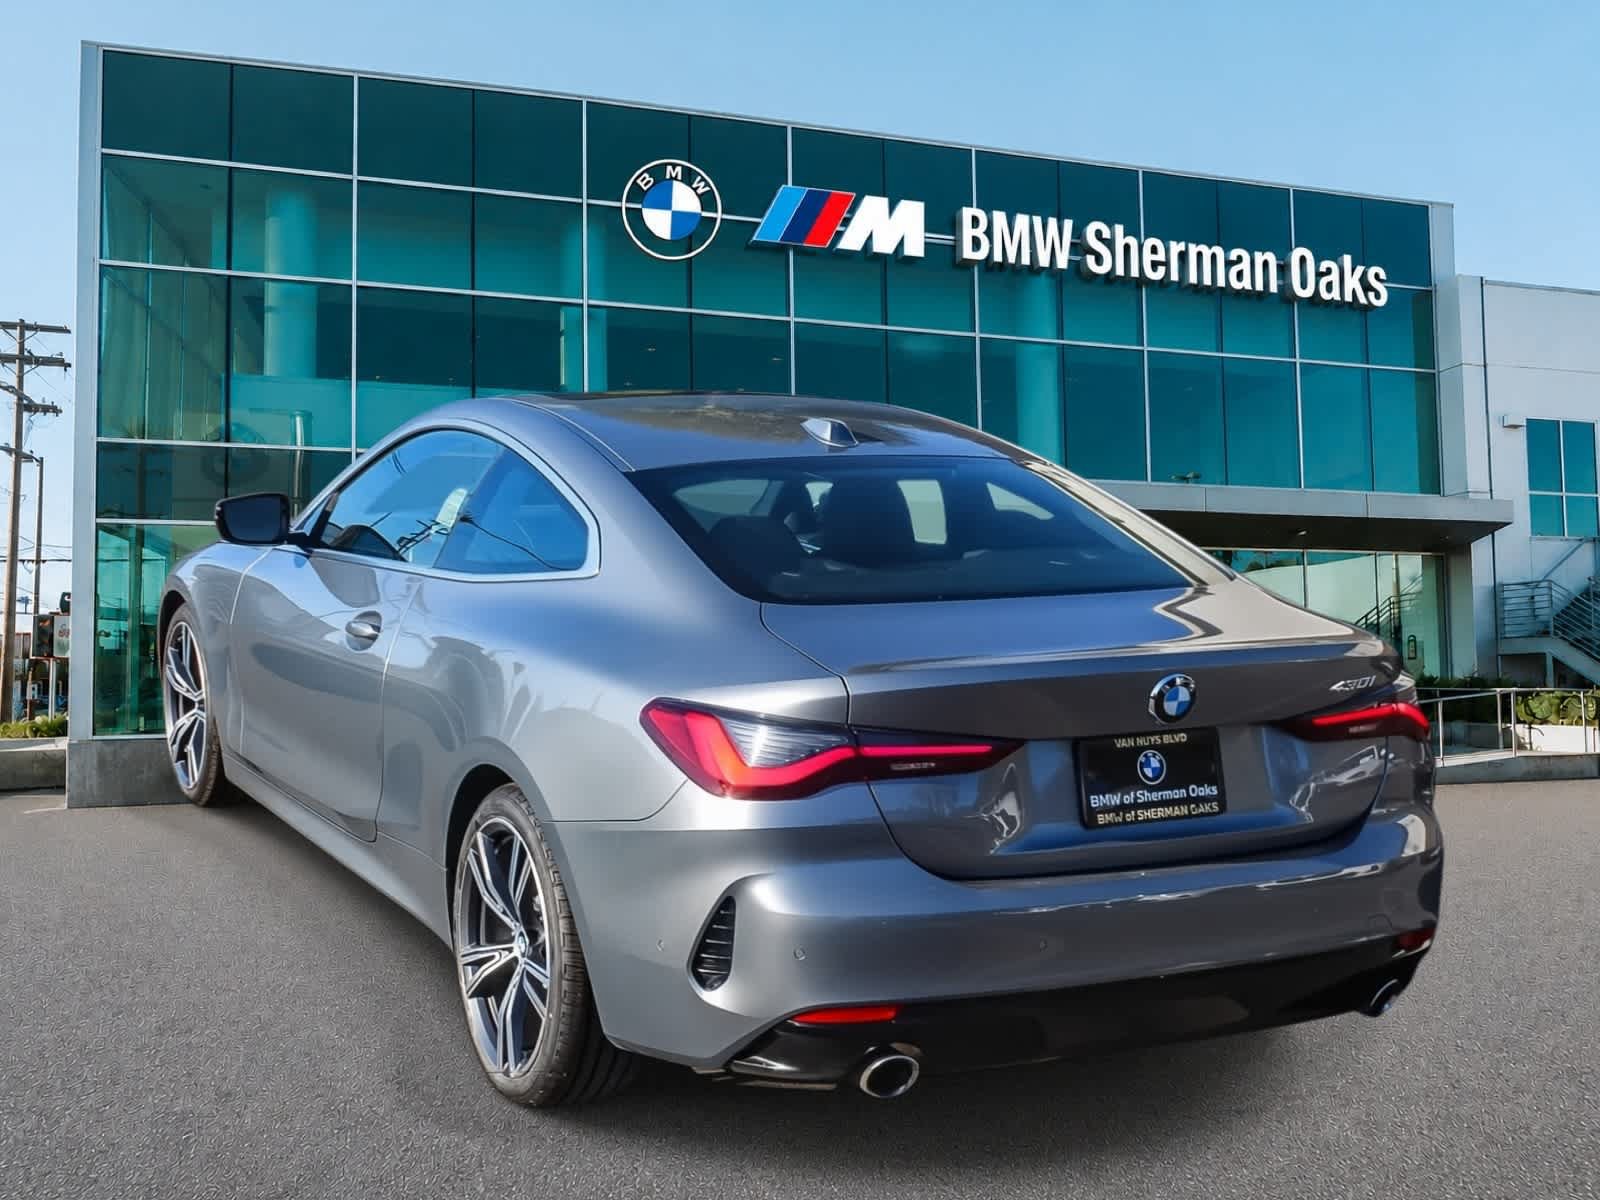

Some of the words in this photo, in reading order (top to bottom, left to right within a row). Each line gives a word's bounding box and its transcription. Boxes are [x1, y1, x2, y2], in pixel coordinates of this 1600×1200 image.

[636, 165, 711, 196] BMW
[961, 206, 1074, 270] BMW
[1085, 221, 1278, 294] Sherman
[1290, 246, 1388, 308] Oaks
[1114, 737, 1135, 748] VAN
[1136, 735, 1161, 746] NUYS
[1163, 732, 1187, 744] BLVD
[1090, 792, 1121, 808] BMW
[1123, 791, 1135, 804] of
[1136, 787, 1187, 803] Sherman
[1189, 783, 1218, 797] Oaks
[1097, 812, 1123, 825] BMW
[1125, 810, 1135, 821] of
[1137, 805, 1188, 821] SHERMAN
